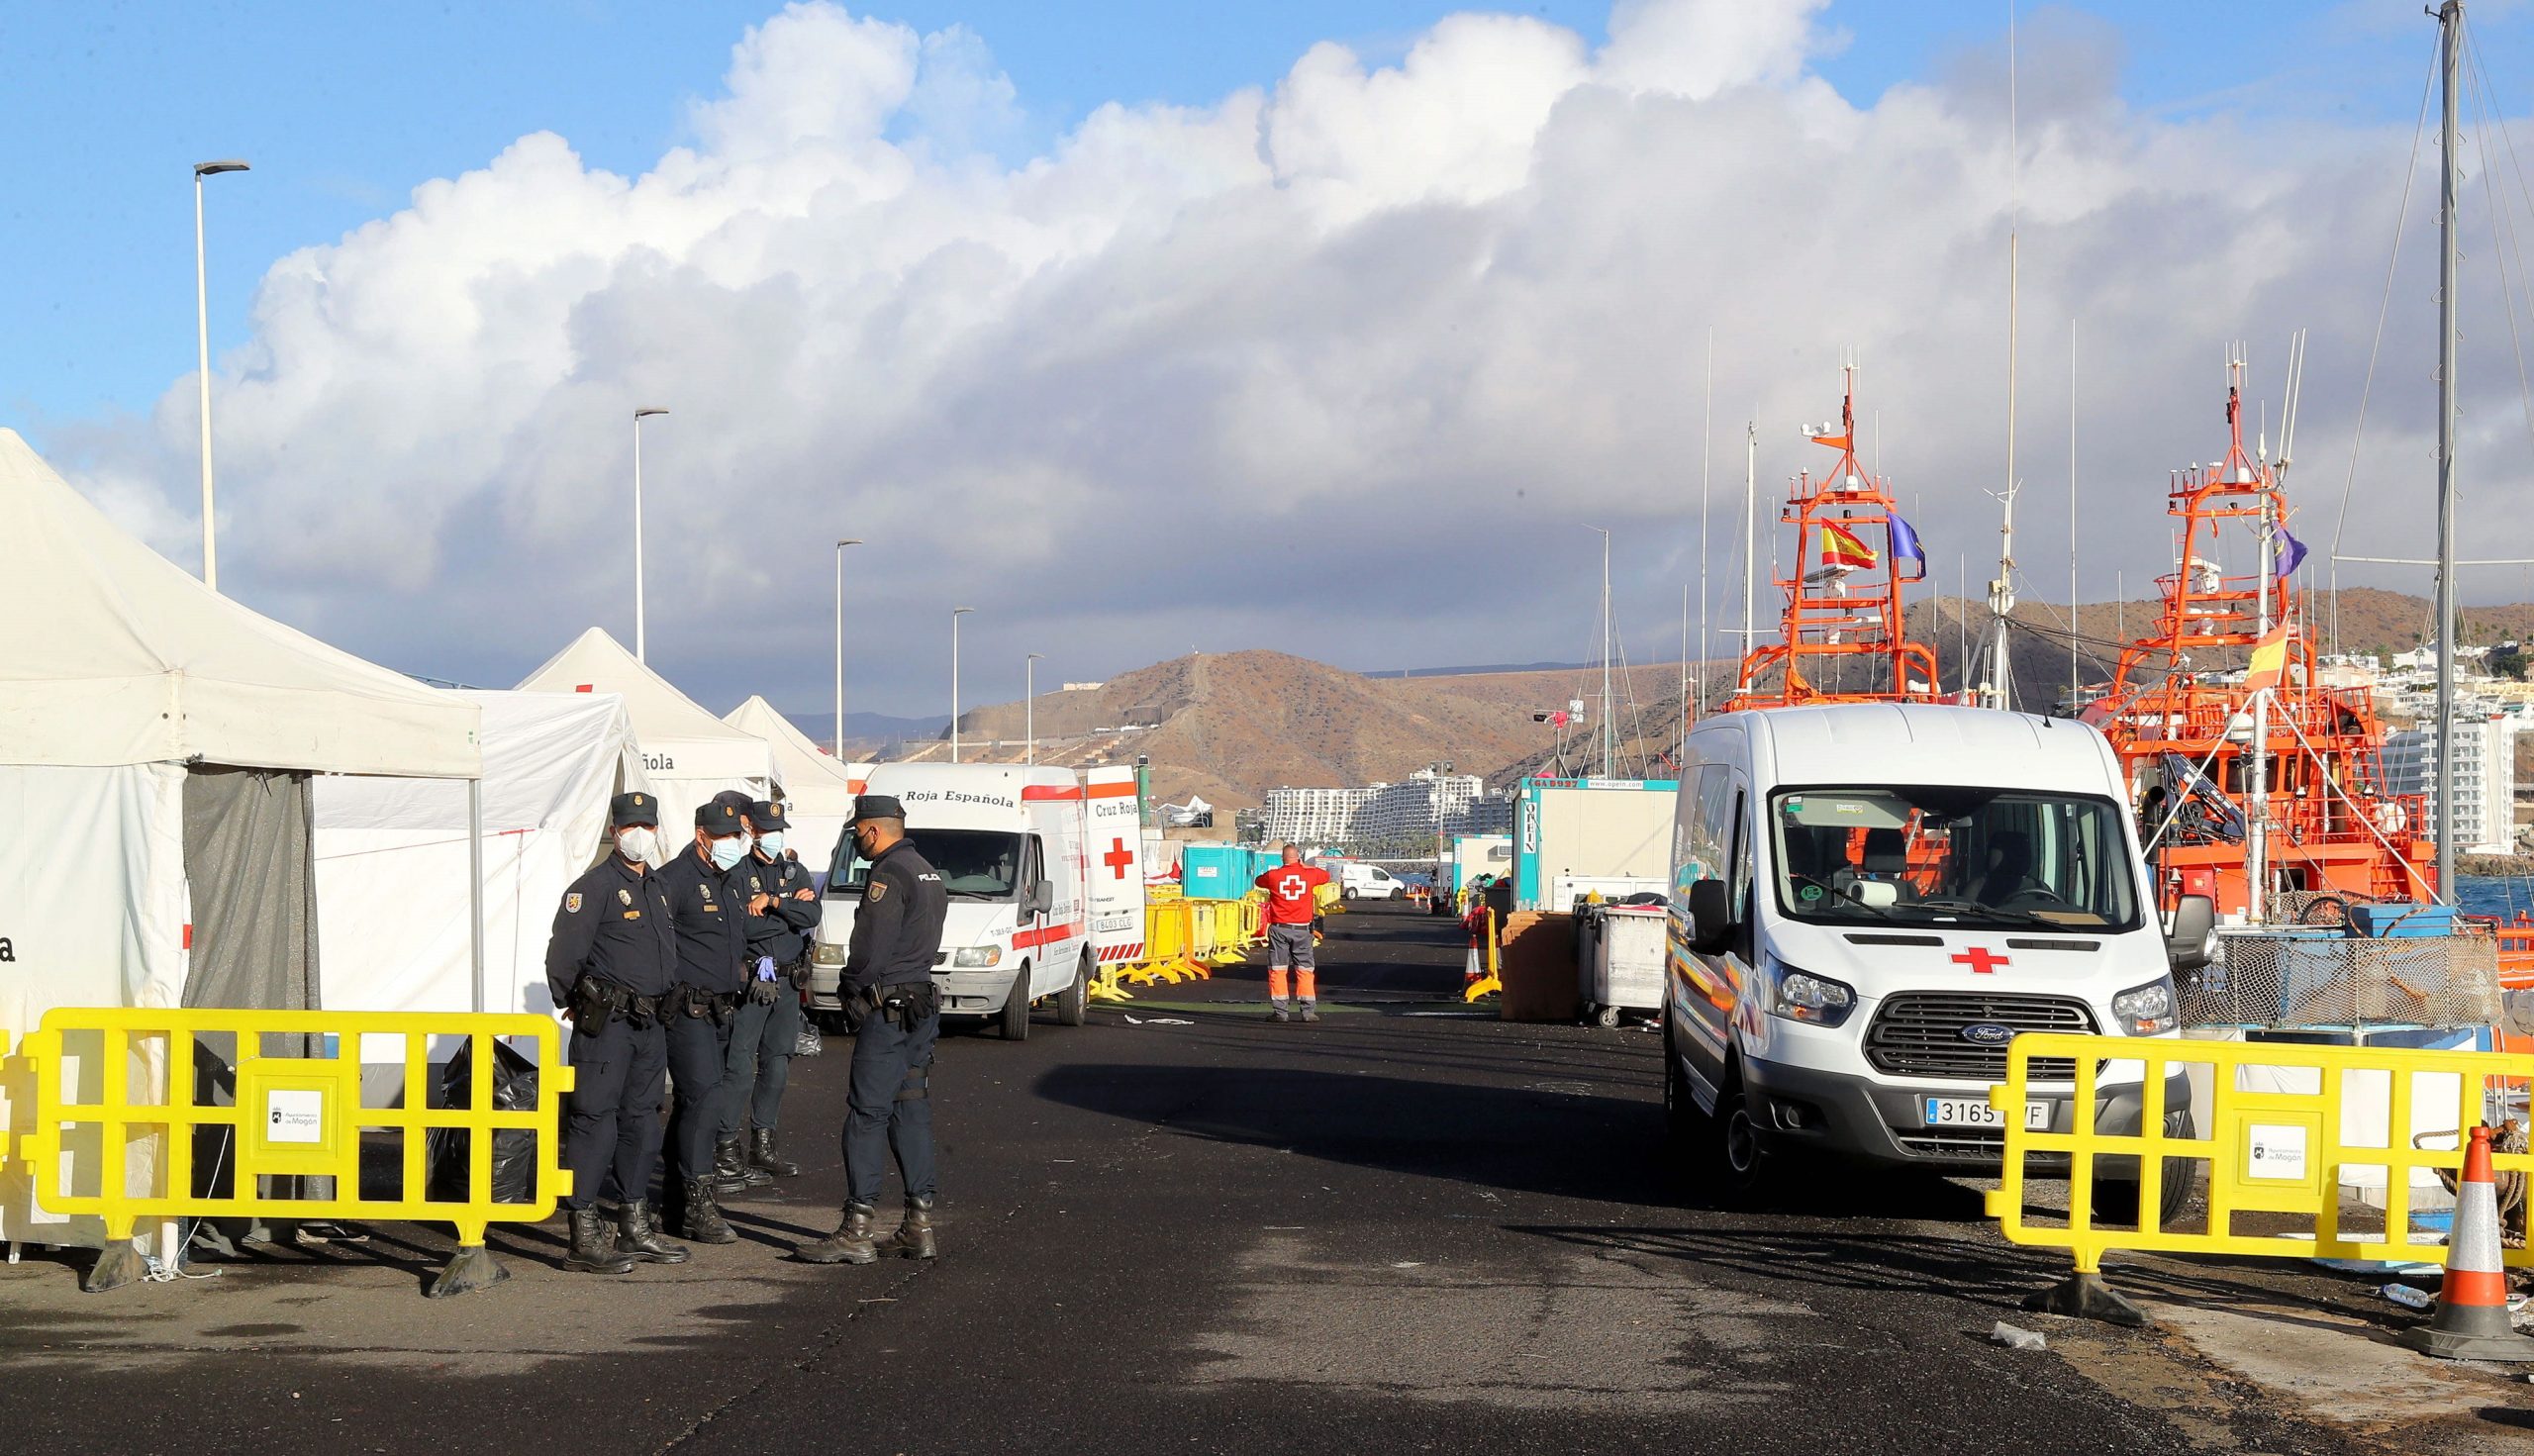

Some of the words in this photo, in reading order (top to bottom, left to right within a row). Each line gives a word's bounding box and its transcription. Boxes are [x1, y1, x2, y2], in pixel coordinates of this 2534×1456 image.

[906, 791, 938, 802] Roja
[944, 791, 1015, 808] Española
[1096, 804, 1118, 818] Cruz
[1120, 801, 1138, 816] Roja
[1100, 920, 1118, 929] 8403
[1119, 918, 1131, 927] CLG
[1974, 1027, 2003, 1040] Ford
[1941, 1103, 1996, 1123] 3165
[292, 1117, 318, 1126] Mogán
